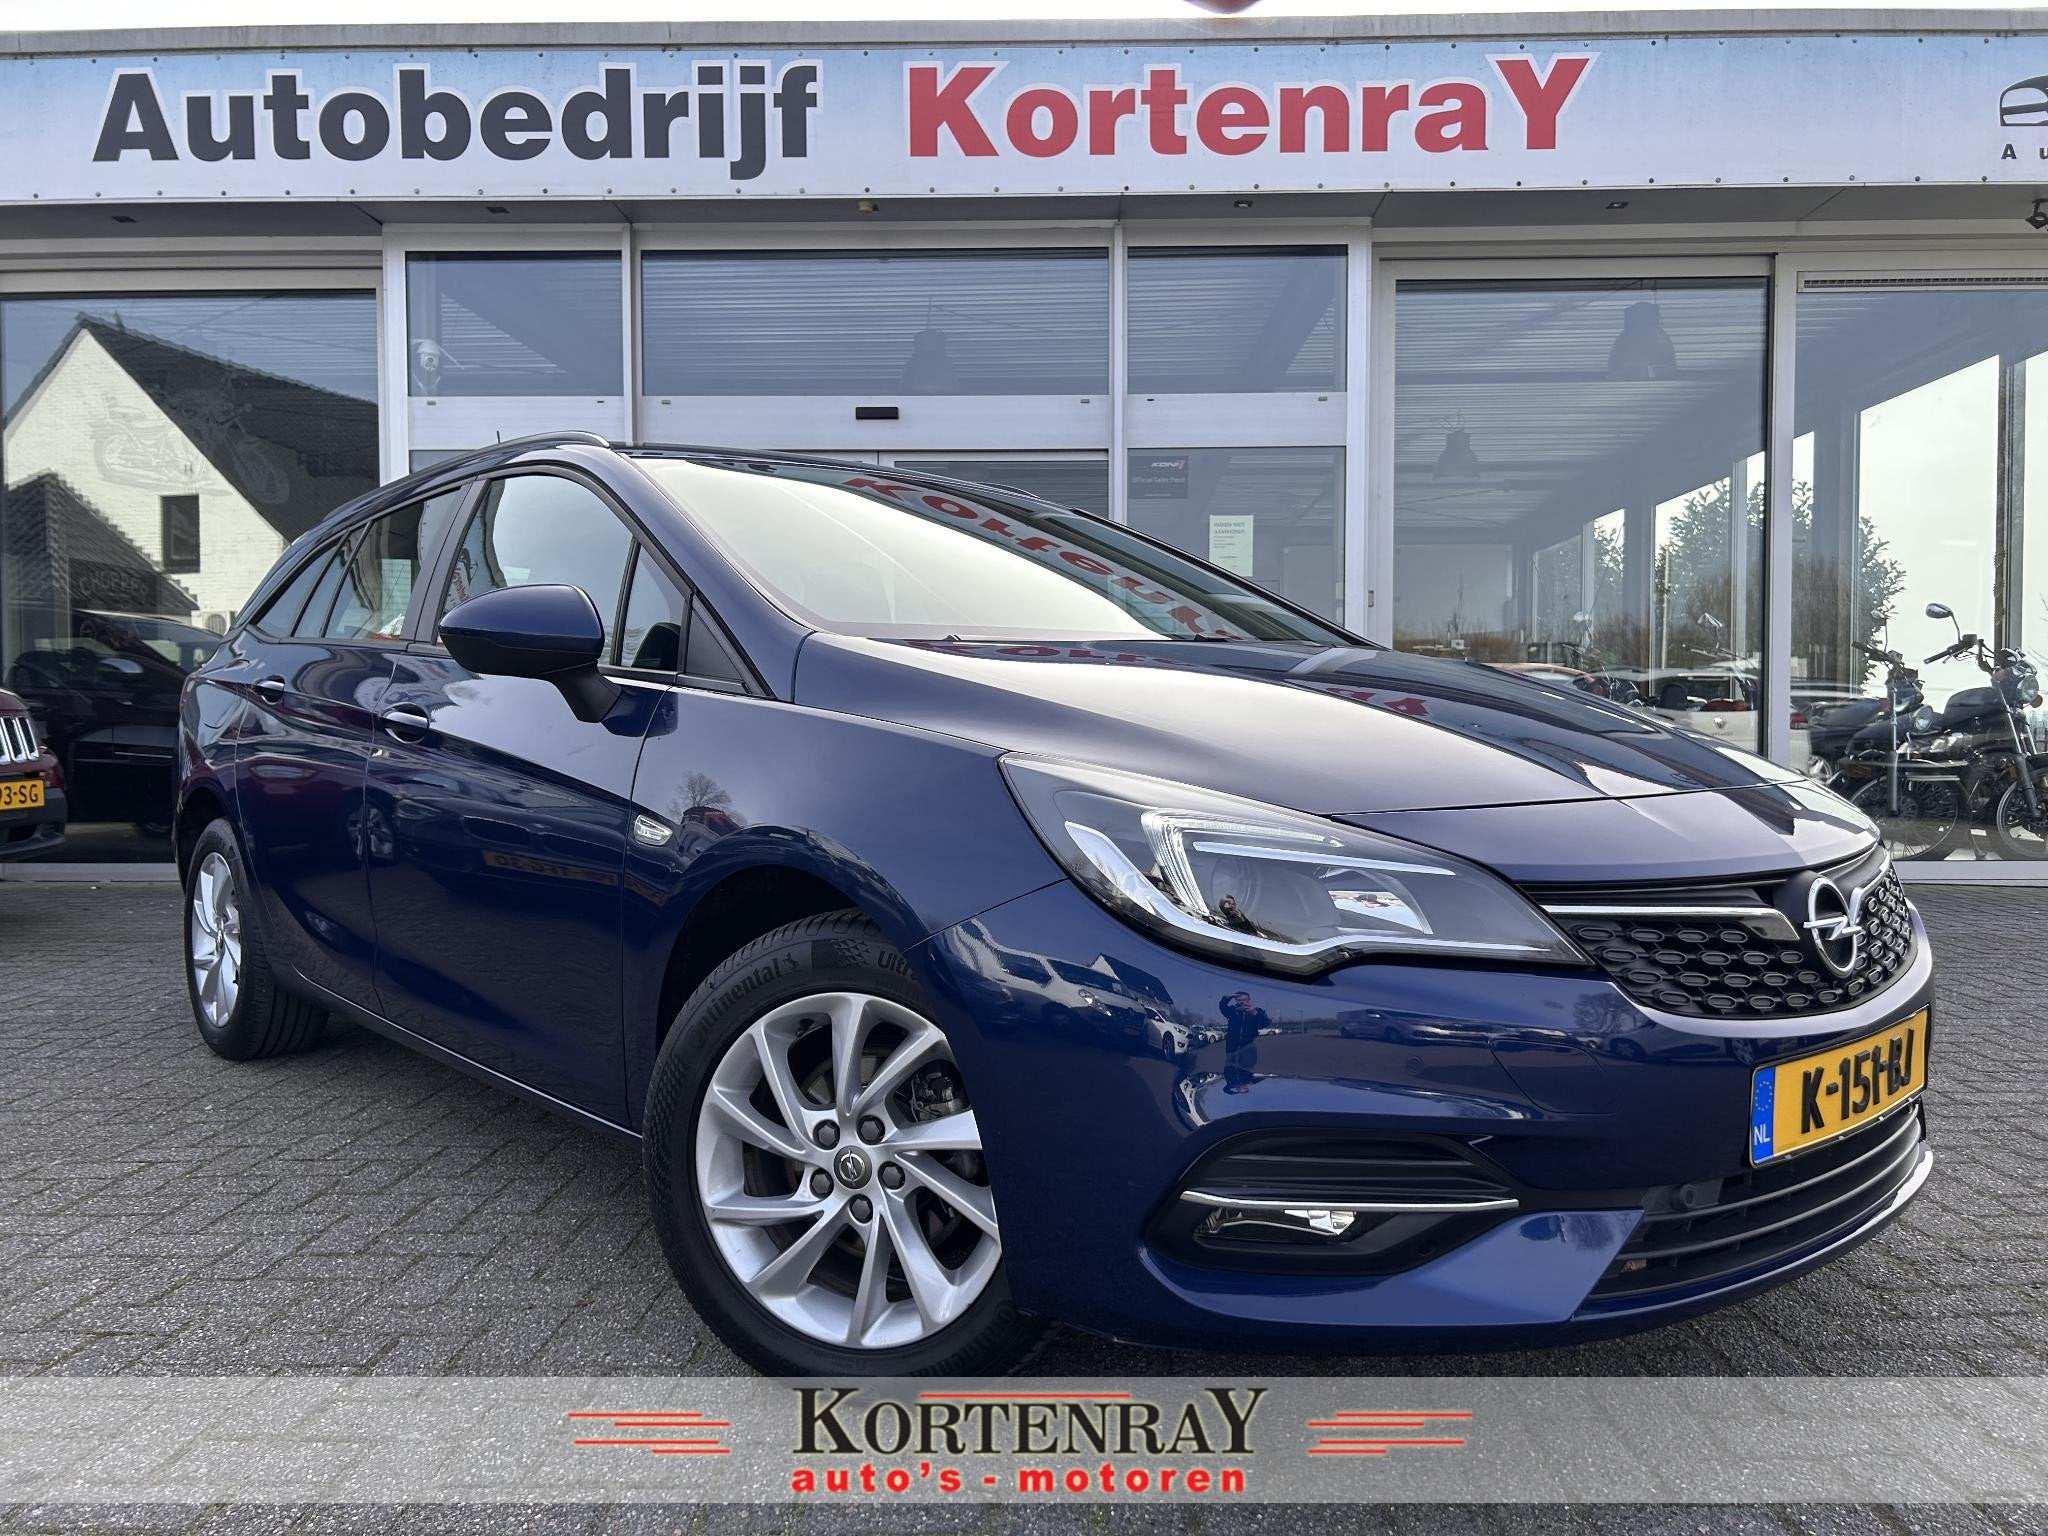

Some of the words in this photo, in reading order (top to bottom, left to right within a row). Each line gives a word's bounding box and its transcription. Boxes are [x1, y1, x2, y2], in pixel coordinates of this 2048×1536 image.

[93, 64, 820, 180] Autobedrijf
[908, 58, 1590, 157] KortenraY
[0, 784, 39, 806] 3-SG
[1800, 1028, 1915, 1135] K-151-BJ
[1753, 1123, 1771, 1146] NL
